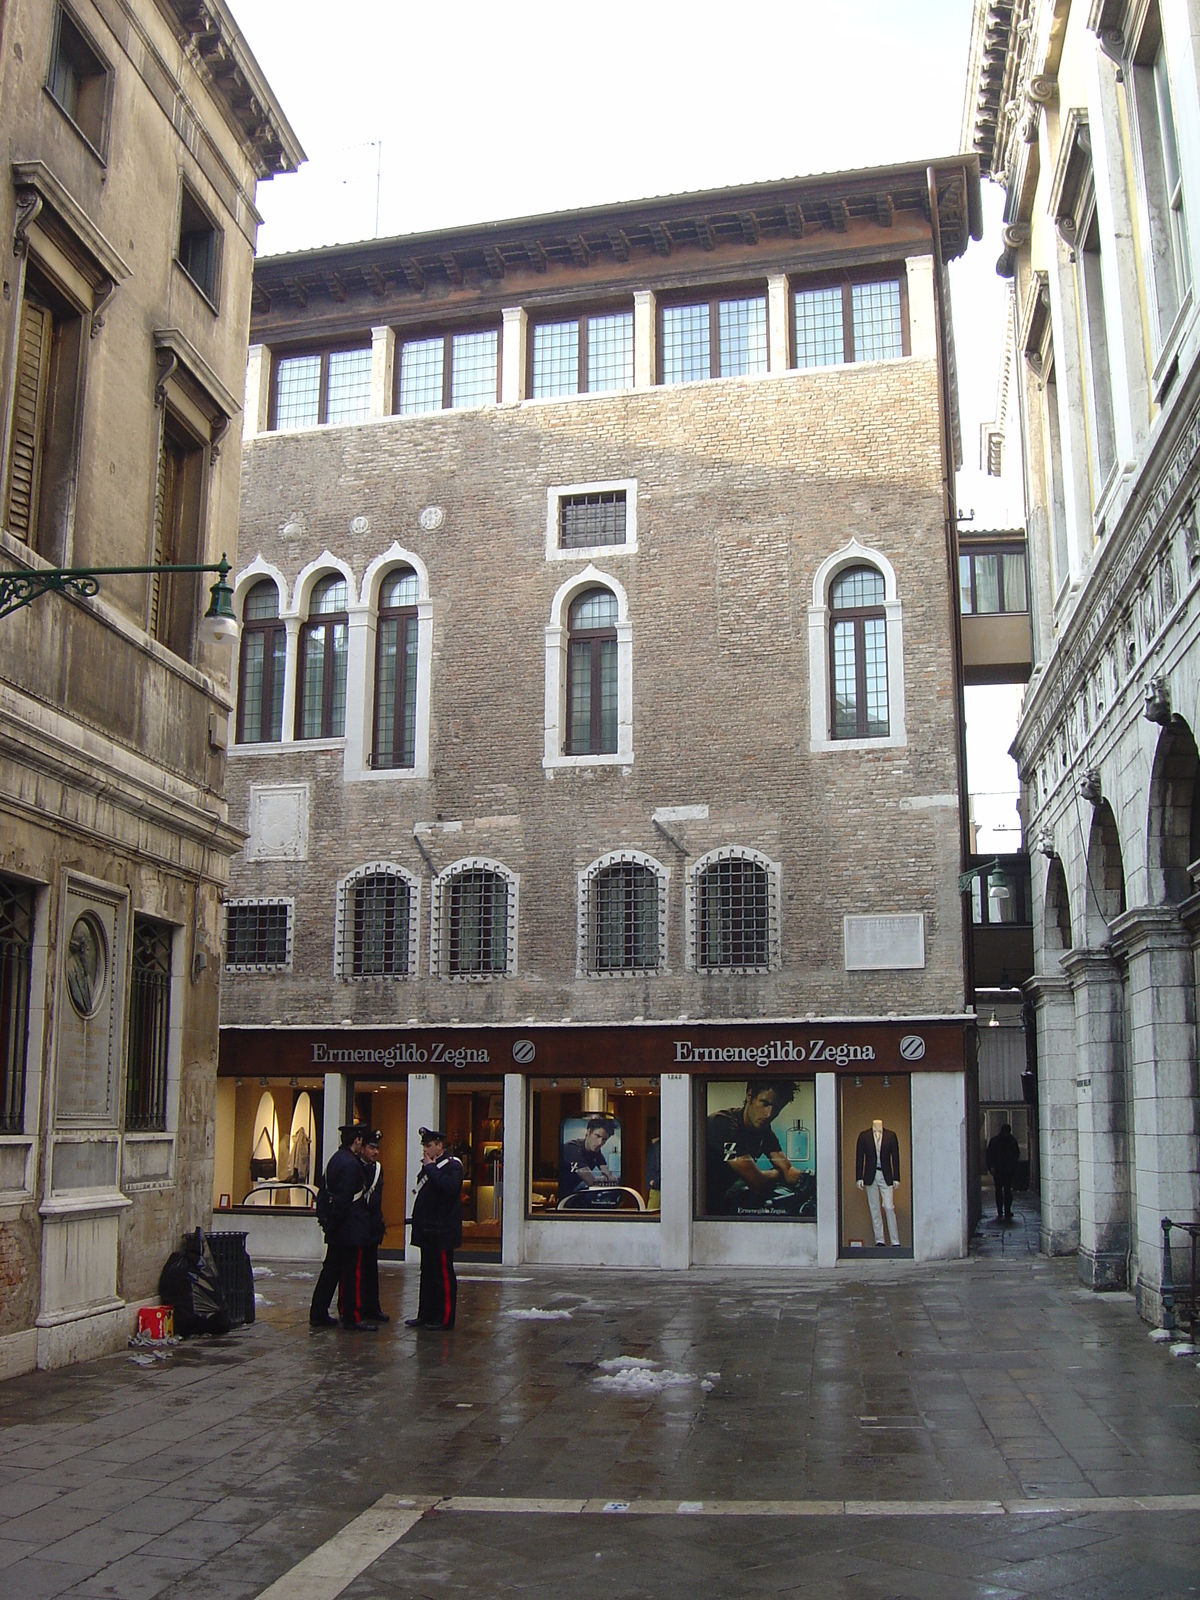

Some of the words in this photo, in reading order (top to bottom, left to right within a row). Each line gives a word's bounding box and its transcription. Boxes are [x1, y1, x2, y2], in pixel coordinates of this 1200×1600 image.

[311, 1043, 428, 1068] Ermenegildo
[430, 1043, 490, 1068] Zegna
[673, 1040, 805, 1067] Ermenegildo
[808, 1040, 876, 1067] Zegna
